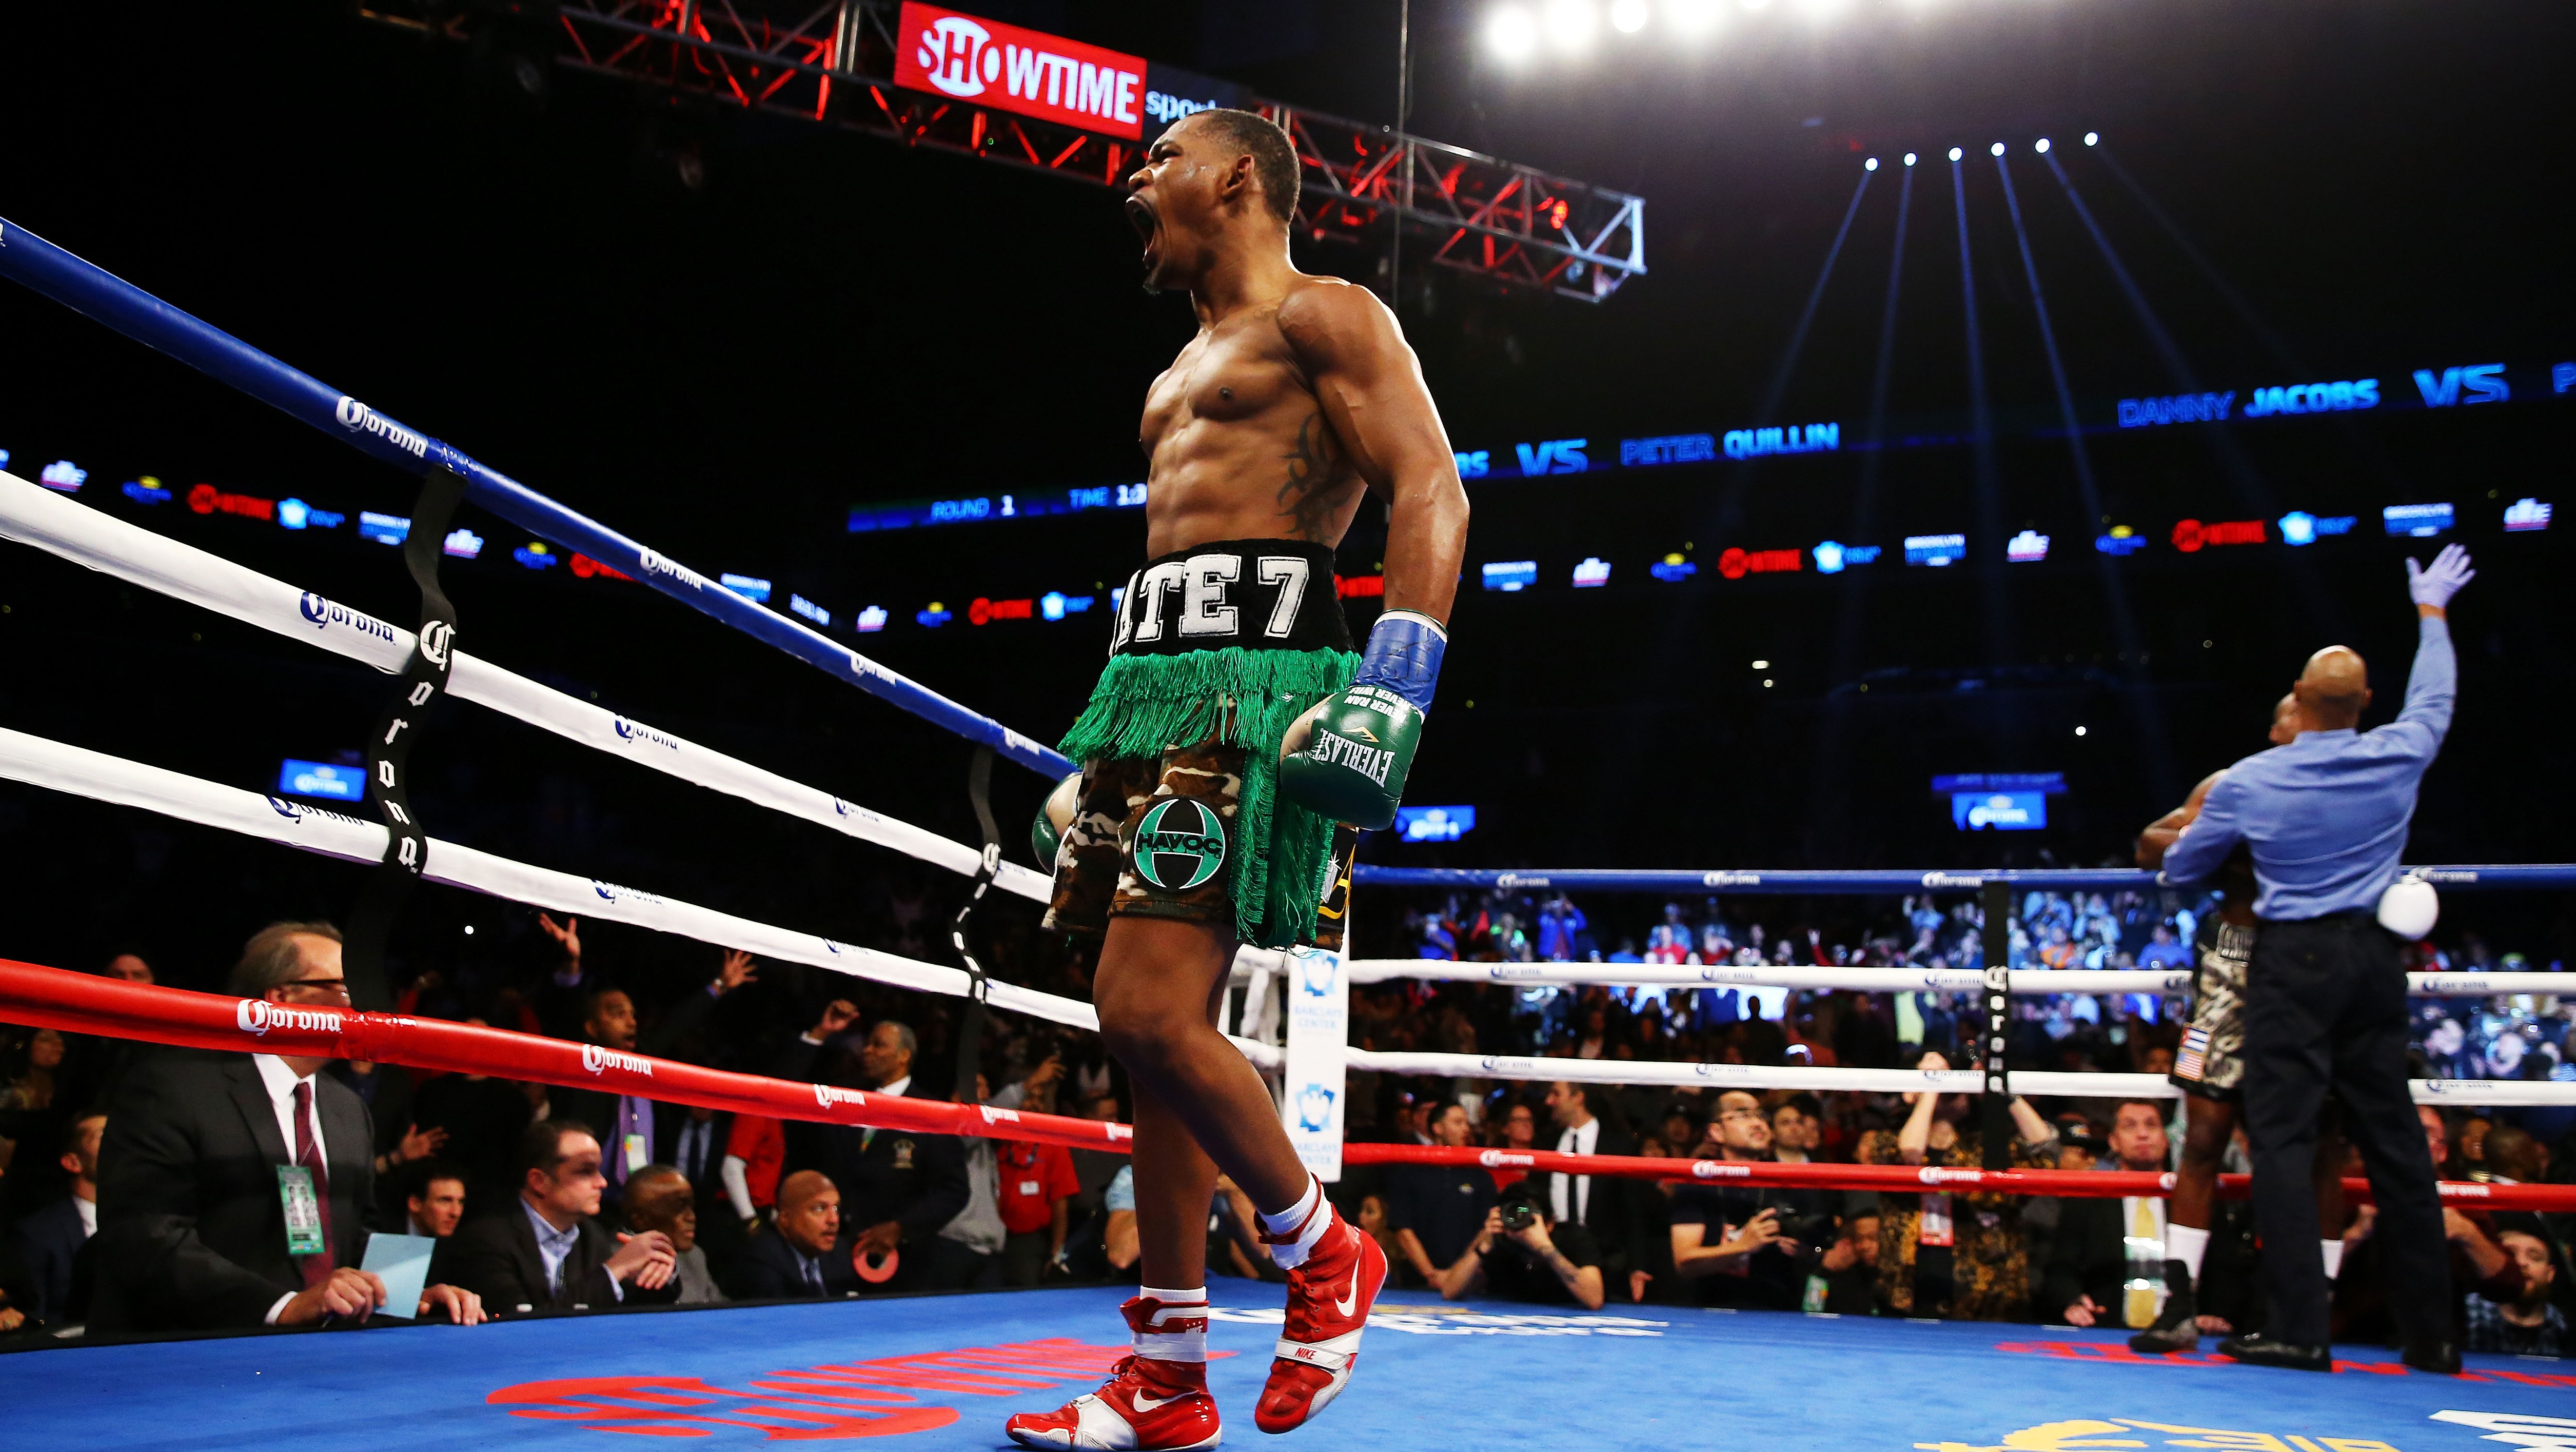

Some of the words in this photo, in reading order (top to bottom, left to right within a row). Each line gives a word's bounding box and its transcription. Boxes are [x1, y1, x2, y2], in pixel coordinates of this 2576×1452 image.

[917, 16, 1139, 125] SHOWTIME
[1145, 91, 1216, 124] spo
[2118, 390, 2236, 428] DANNY
[2244, 378, 2380, 417] JACOBS
[2412, 363, 2510, 408] VS
[336, 395, 429, 458] Corona
[1516, 439, 1588, 477] VS
[1620, 433, 1715, 465] PETER
[1723, 423, 1839, 460] QUILLIN
[931, 498, 990, 521] ROUND
[1001, 495, 1015, 516] 1
[1069, 487, 1110, 511] TIME
[1116, 483, 1147, 506] 1:3
[640, 546, 702, 591] Corona
[1258, 556, 1309, 638] 7
[301, 591, 395, 642] Corona
[1344, 695, 1371, 707] RAN
[1370, 699, 1407, 724] NEVER
[1375, 688, 1411, 711] NEVER
[379, 620, 456, 868] Corona
[1313, 728, 1395, 788] EVERLAST
[1136, 833, 1223, 854] HAVOC
[238, 998, 343, 1036] Corona
[582, 1043, 653, 1077] Corona
[814, 1083, 866, 1110] Corona
[1480, 1149, 1535, 1167] Corona
[1692, 1160, 1751, 1178] Corona
[2435, 1181, 2491, 1198] orona
[1295, 1347, 1317, 1360] NIKE
